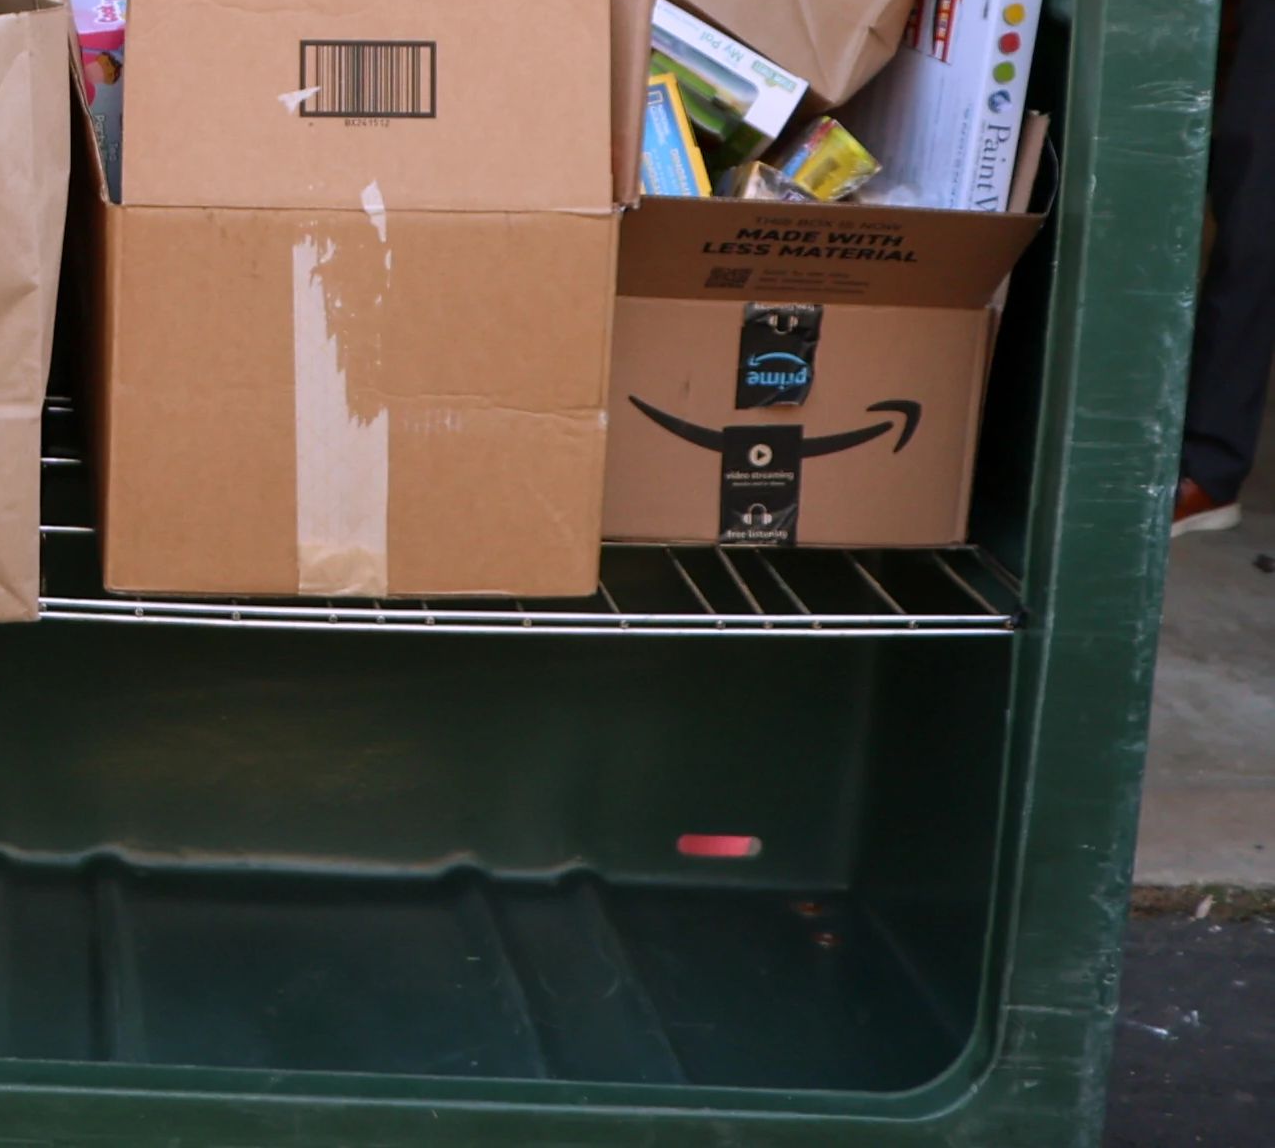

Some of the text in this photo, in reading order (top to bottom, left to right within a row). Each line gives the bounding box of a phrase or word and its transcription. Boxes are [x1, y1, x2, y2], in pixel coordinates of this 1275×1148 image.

[699, 30, 721, 49] Pal
[977, 123, 1012, 192] Paint
[756, 216, 904, 231] THIS BOX IS NOW
[736, 228, 905, 246] MADE WITH
[702, 242, 919, 262] LESS MATERIAL
[747, 367, 808, 390] prime
